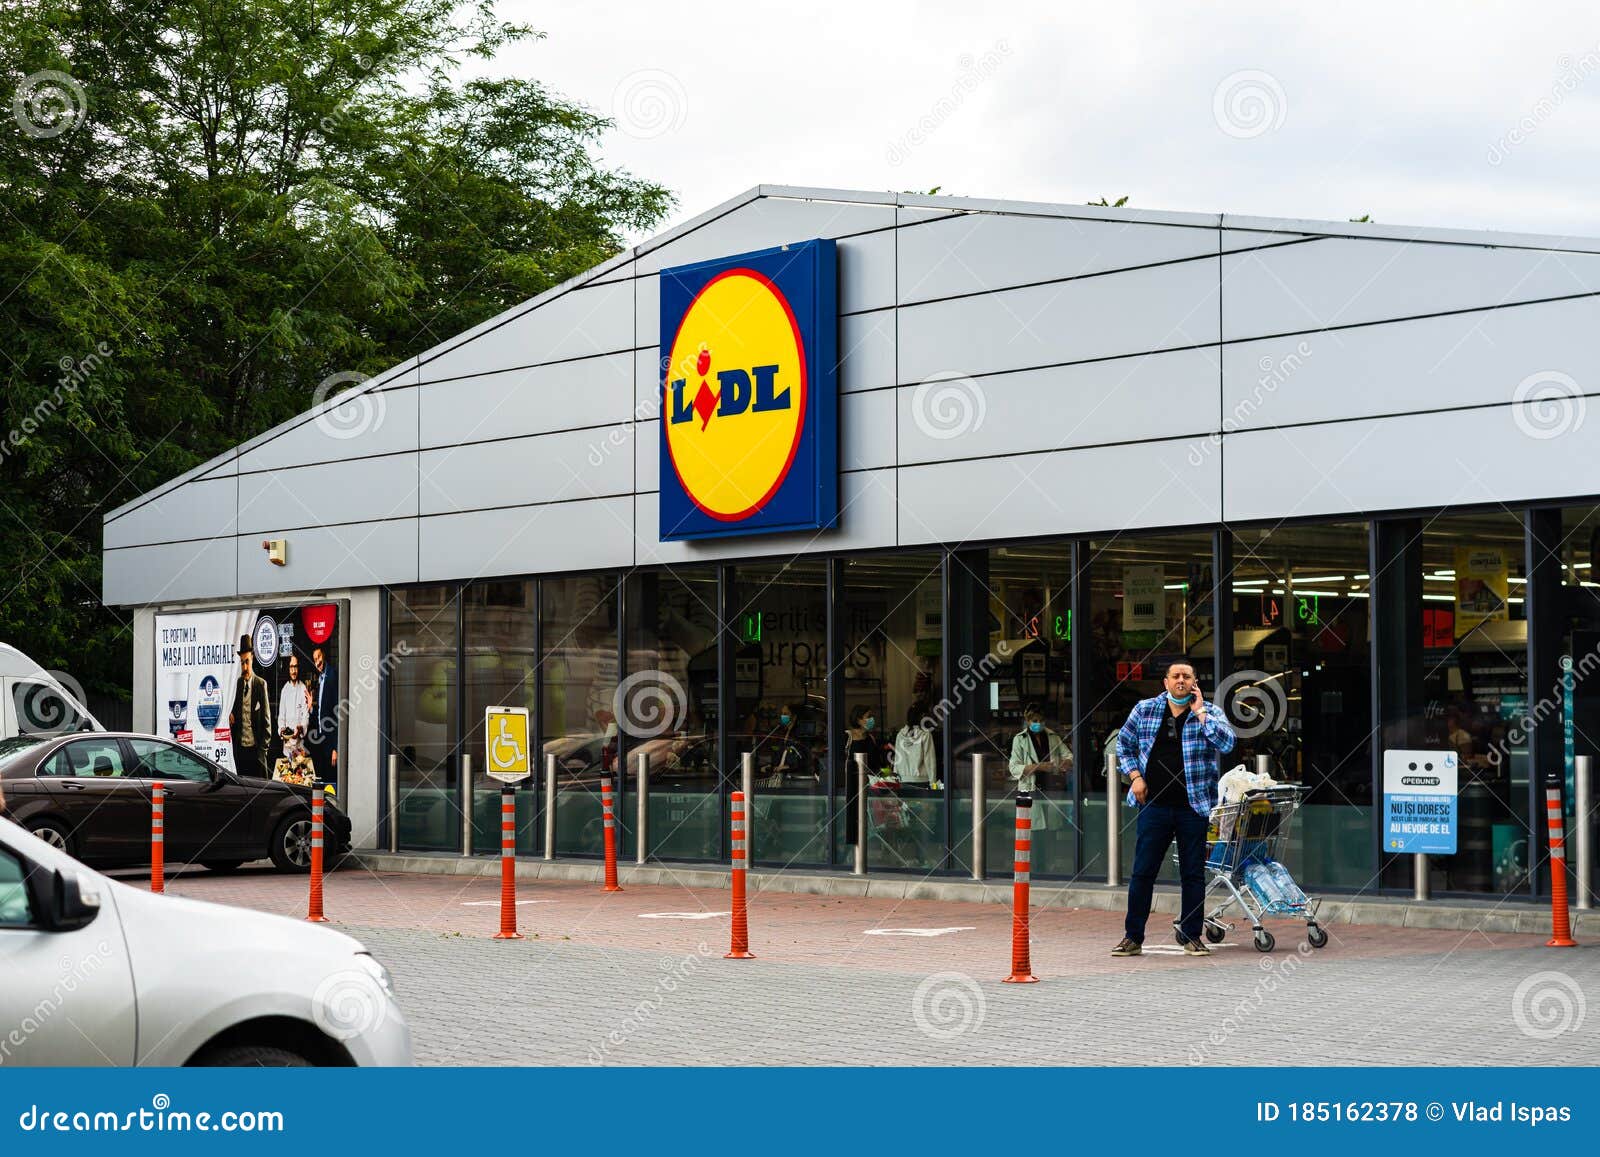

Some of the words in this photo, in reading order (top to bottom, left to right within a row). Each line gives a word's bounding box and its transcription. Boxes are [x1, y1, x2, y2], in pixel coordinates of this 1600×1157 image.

[162, 629, 169, 643] TE
[170, 628, 188, 643] POFTIM
[190, 627, 197, 641] LA
[162, 647, 181, 667] MASA
[184, 646, 196, 666] LUI
[198, 644, 235, 665] CARAGIALE
[1391, 803, 1402, 815] NU
[1417, 803, 1450, 815] DORESC
[1390, 823, 1401, 833] AU
[1402, 823, 1429, 834] NEVOIE
[1430, 824, 1440, 834] DE
[1441, 824, 1451, 834] EL
